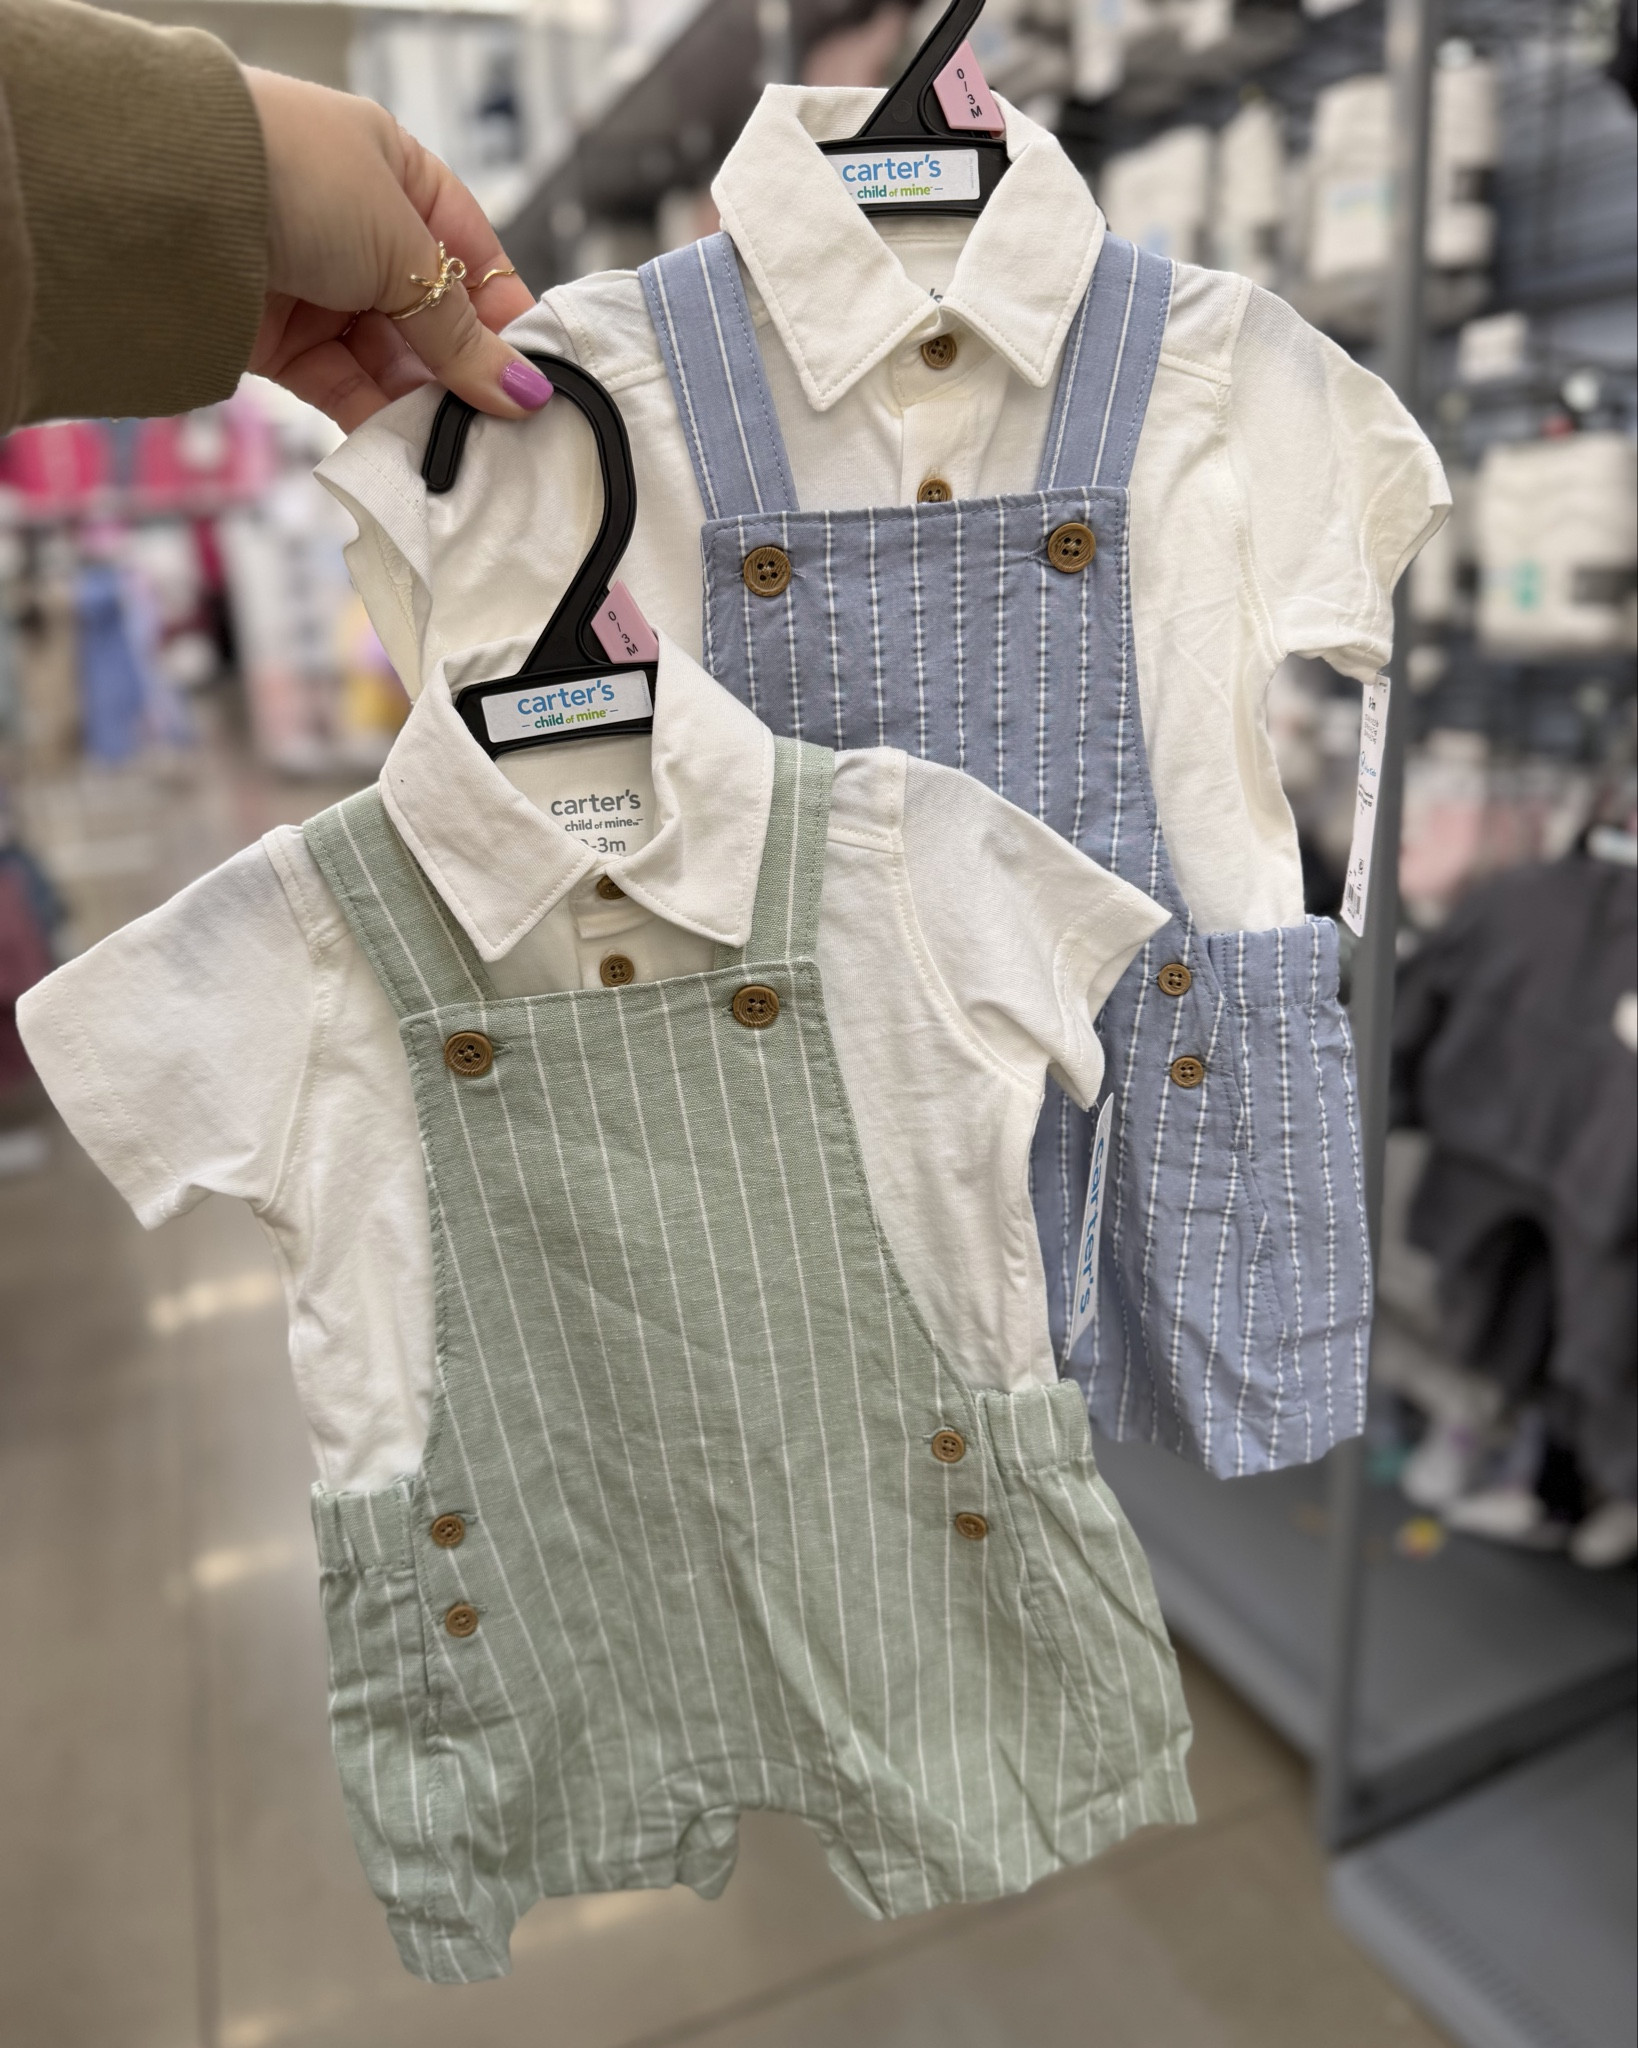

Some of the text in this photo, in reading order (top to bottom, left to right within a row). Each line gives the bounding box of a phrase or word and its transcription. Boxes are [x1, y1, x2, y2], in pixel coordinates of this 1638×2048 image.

[842, 154, 942, 183] carter's
[857, 184, 887, 199] child
[889, 188, 899, 197] of
[517, 680, 615, 715] carter's
[534, 713, 564, 729] child
[565, 714, 575, 724] of
[551, 789, 641, 816] carter's
[565, 819, 593, 832] child
[594, 821, 603, 830] of
[1079, 1136, 1105, 1315] carter's
